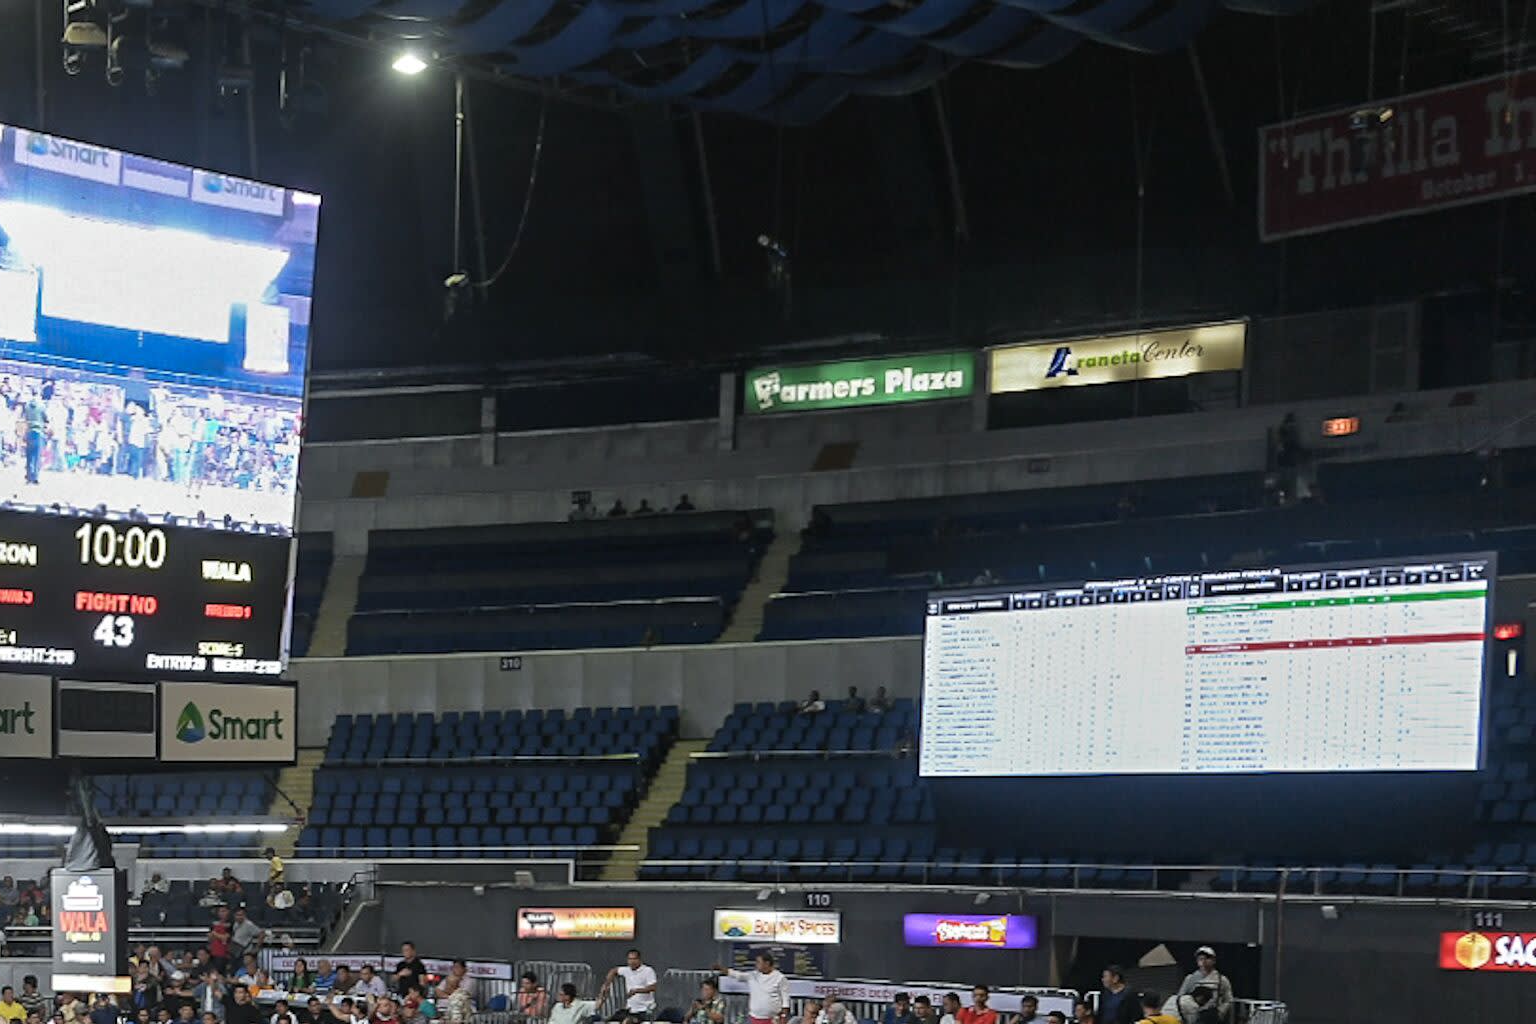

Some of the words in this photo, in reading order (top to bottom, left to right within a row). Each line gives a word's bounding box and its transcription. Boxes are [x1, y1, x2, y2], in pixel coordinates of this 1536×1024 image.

[1141, 339, 1207, 364] Center
[753, 371, 876, 409] Farmers
[885, 367, 963, 395] Plaza
[74, 522, 166, 568] 10:00
[75, 591, 130, 612] FIGHT
[131, 594, 158, 615] NO
[94, 615, 134, 647] 43
[208, 708, 284, 741] Smart
[806, 893, 831, 907] 110
[59, 911, 109, 932] WALA
[1474, 911, 1503, 927] 111
